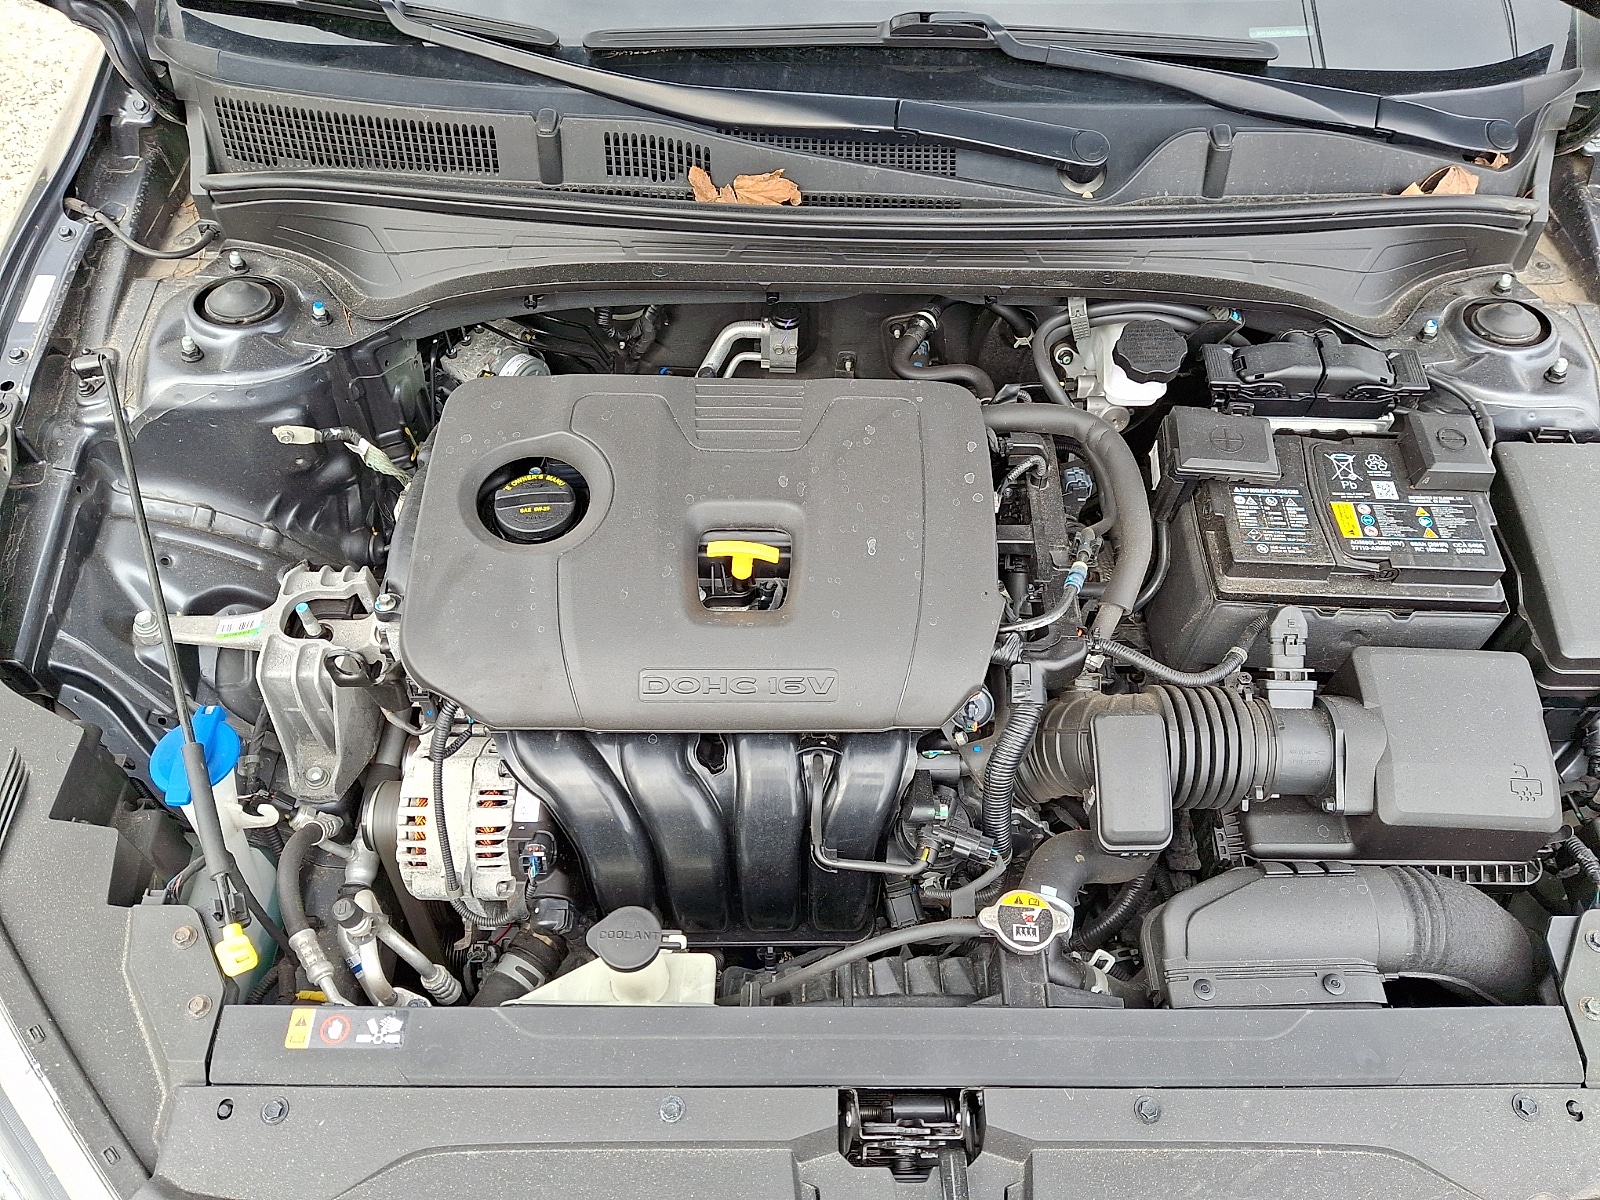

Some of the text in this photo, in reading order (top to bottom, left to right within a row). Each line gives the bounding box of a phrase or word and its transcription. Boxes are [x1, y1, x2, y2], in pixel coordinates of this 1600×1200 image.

[511, 474, 544, 487] OWNER'S
[1341, 480, 1358, 489] Pb
[519, 506, 532, 514] SAE
[642, 676, 836, 695] DOHC 16V
[599, 929, 660, 941] COOLANT
